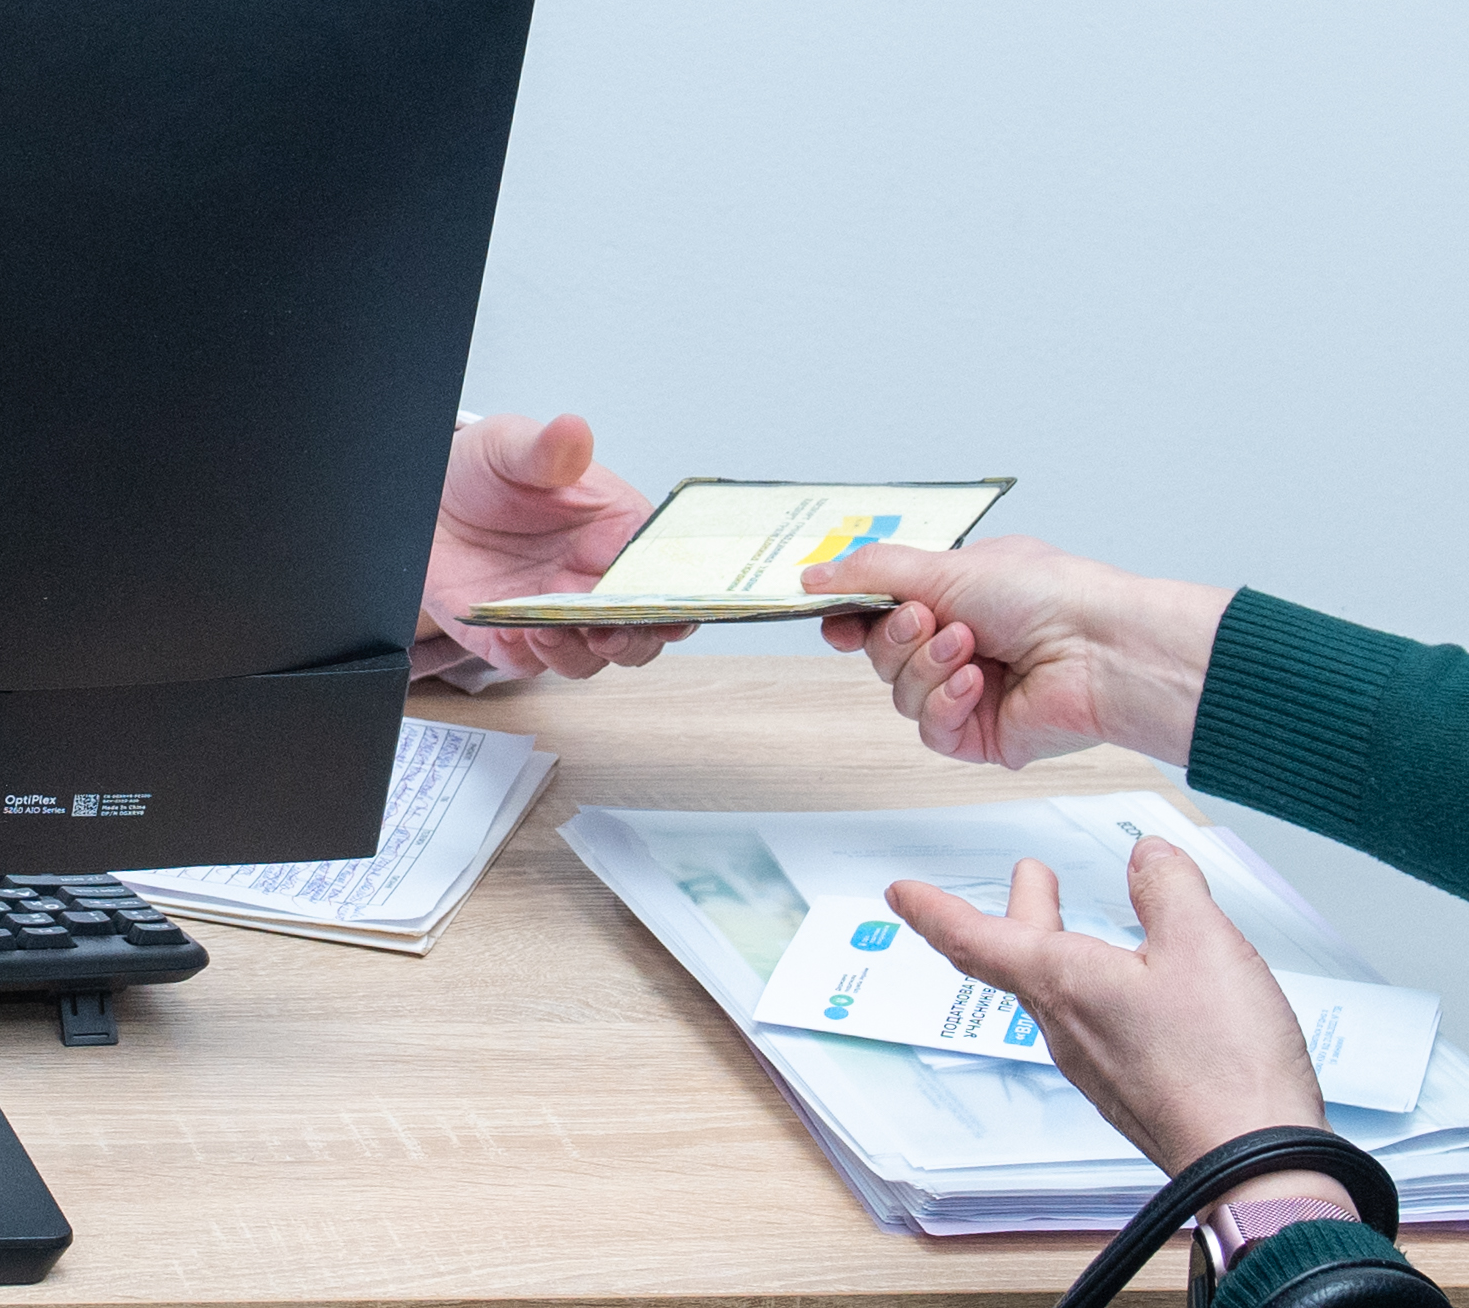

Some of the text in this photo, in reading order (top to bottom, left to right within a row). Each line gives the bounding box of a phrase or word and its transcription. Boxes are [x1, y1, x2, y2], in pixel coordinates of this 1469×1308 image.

[4, 795, 57, 806] OptiPlex
[939, 982, 976, 1039] ПОДАТКОВА
[963, 987, 997, 1039] УЧАСНИКІВ
